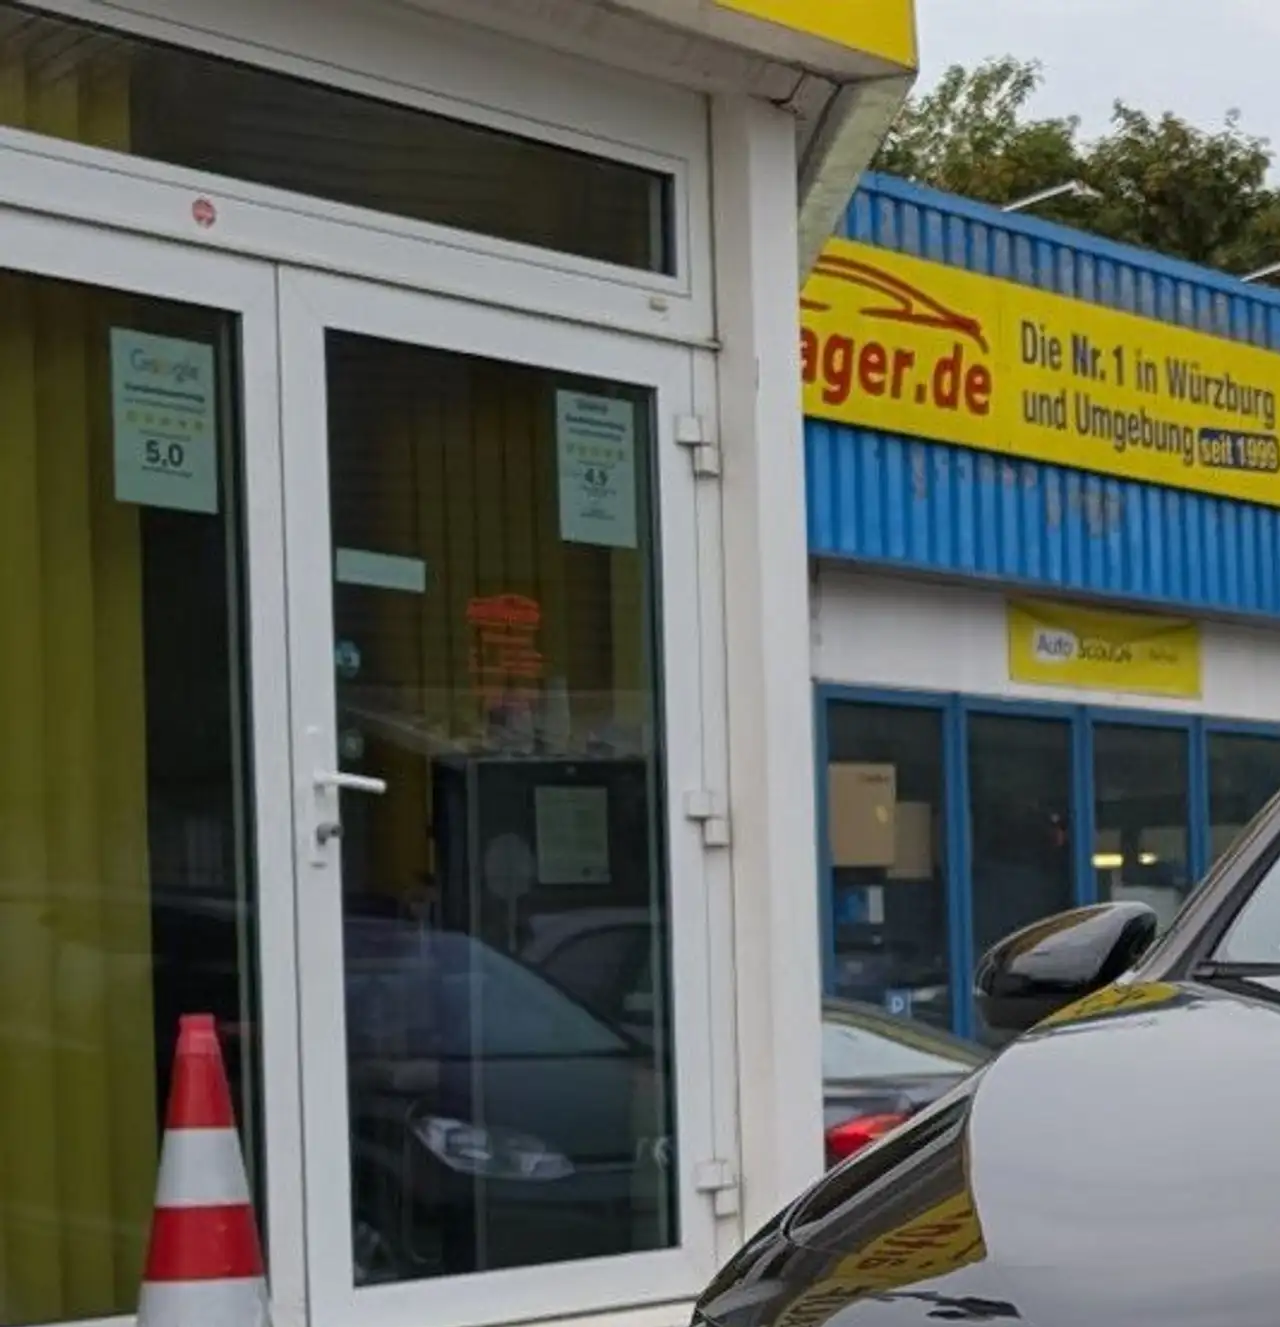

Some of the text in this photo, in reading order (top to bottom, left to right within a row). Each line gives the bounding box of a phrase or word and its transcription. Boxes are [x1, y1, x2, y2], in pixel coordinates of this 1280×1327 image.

[1021, 320, 1275, 430] Die Nr. 1 in Würzburg
[145, 439, 184, 467] 5.0
[1023, 388, 1067, 430] und
[1074, 392, 1195, 466] Umgebung
[1200, 434, 1233, 467] seit
